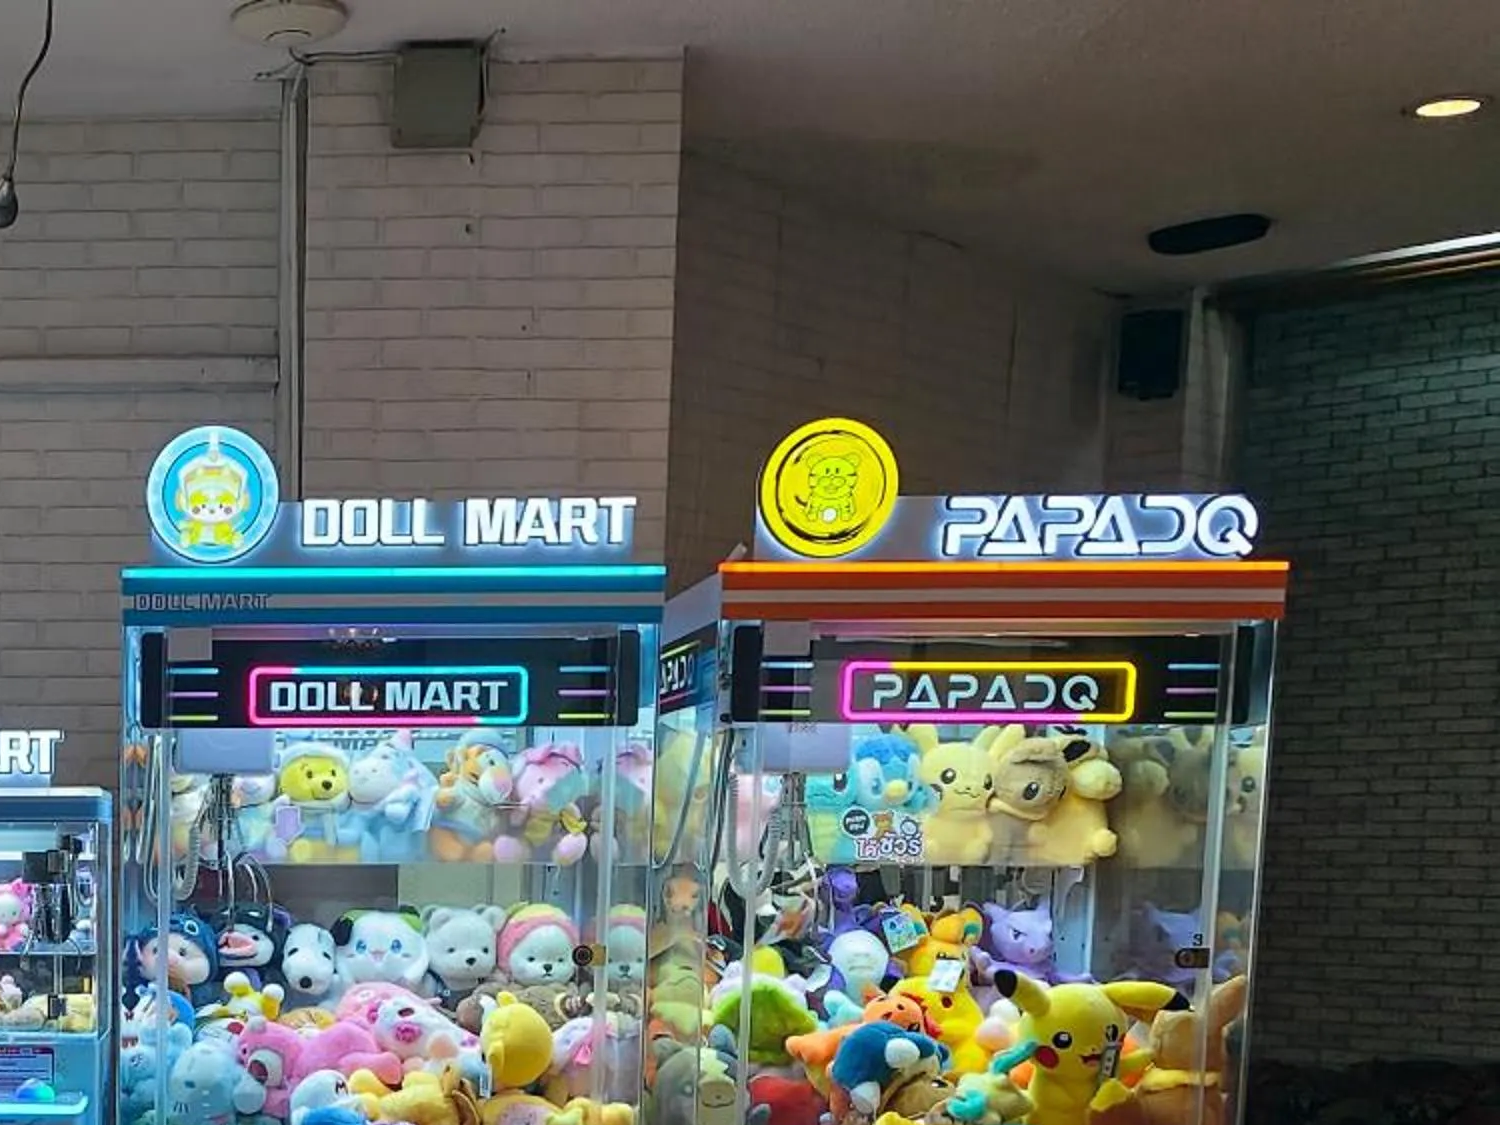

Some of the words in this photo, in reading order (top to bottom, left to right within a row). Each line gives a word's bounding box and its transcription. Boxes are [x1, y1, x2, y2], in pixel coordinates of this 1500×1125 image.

[301, 497, 445, 546] DOLL
[464, 495, 638, 545] MART
[940, 493, 1260, 556] PAPADQ
[133, 593, 197, 611] DOLL
[200, 592, 269, 611] MART
[269, 680, 376, 712] DOLL
[385, 679, 509, 711] MART
[872, 674, 1100, 710] PAPADQ
